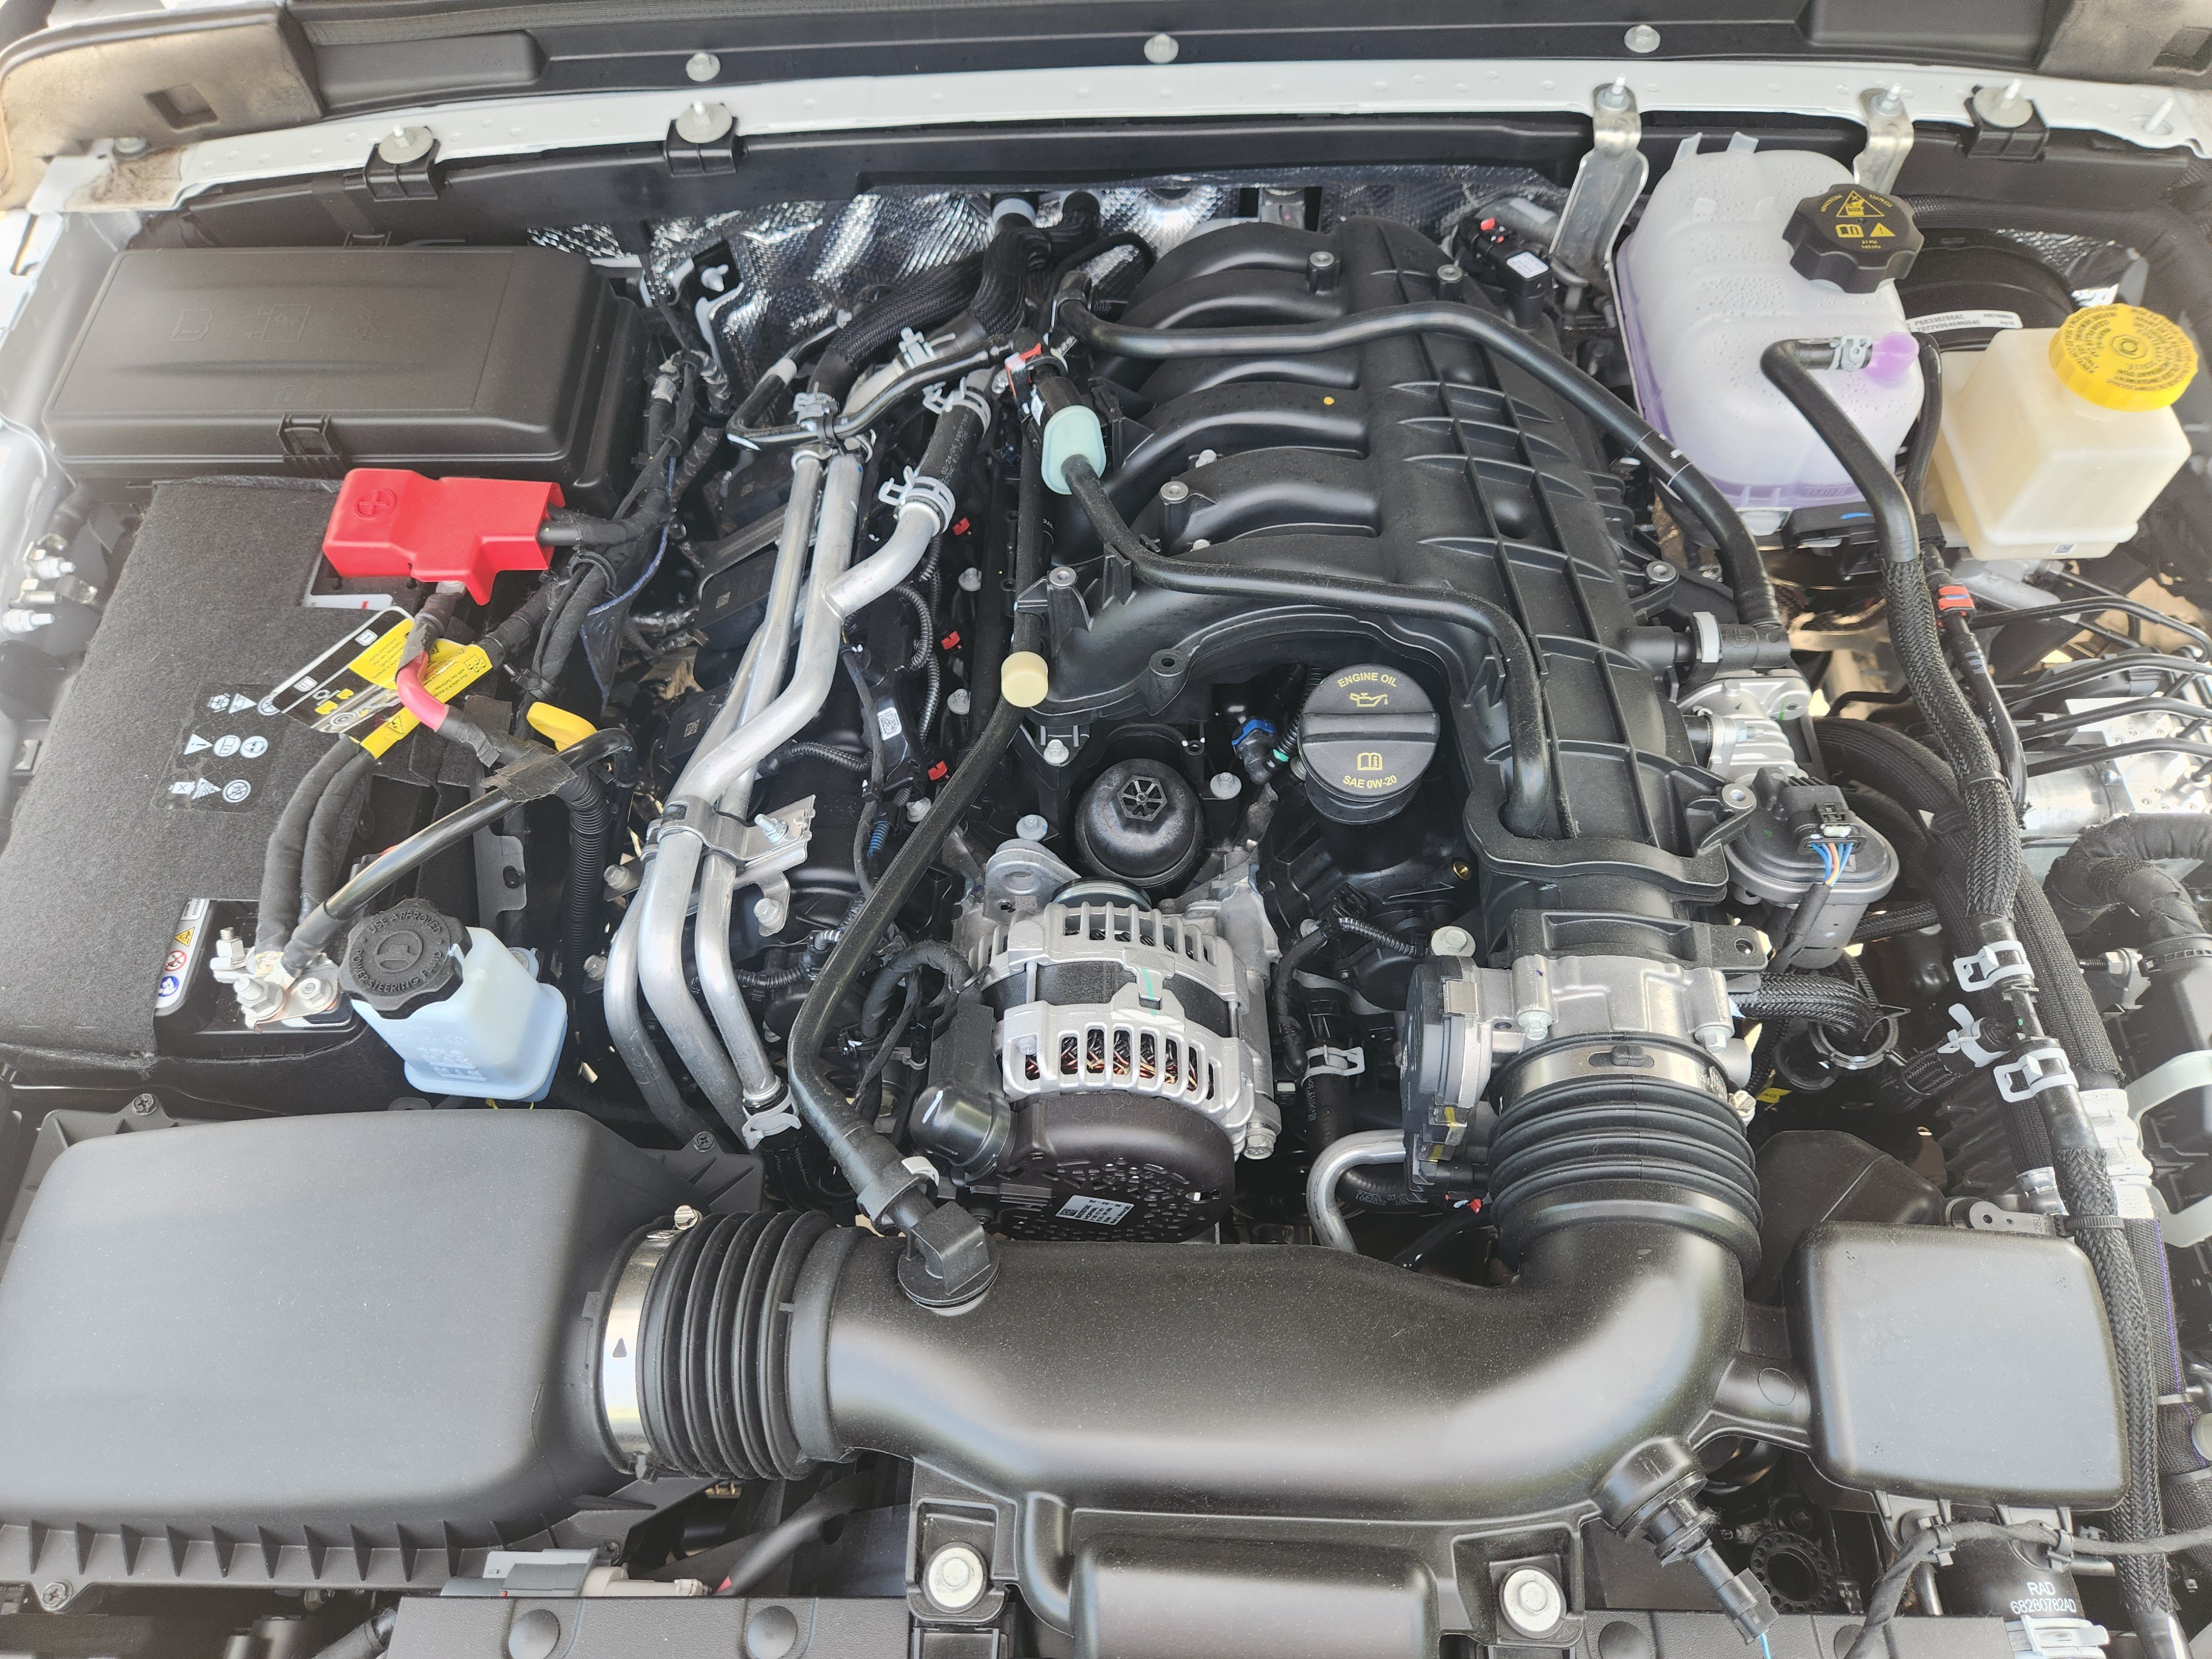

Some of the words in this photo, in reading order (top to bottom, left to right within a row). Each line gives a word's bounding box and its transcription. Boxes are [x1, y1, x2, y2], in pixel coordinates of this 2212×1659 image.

[1337, 672, 1378, 687] ENGINE
[1380, 674, 1397, 687] OIL
[1343, 775, 1365, 789] SAE
[1367, 775, 1397, 789] 0W-20
[367, 918, 388, 933] USE
[390, 911, 442, 934] APPROVED
[352, 948, 369, 983] POWER
[367, 976, 420, 993] STEERING
[421, 950, 442, 977] FLUID
[2026, 1582, 2056, 1596] RAD
[2010, 1597, 2077, 1615] 68280782AD
